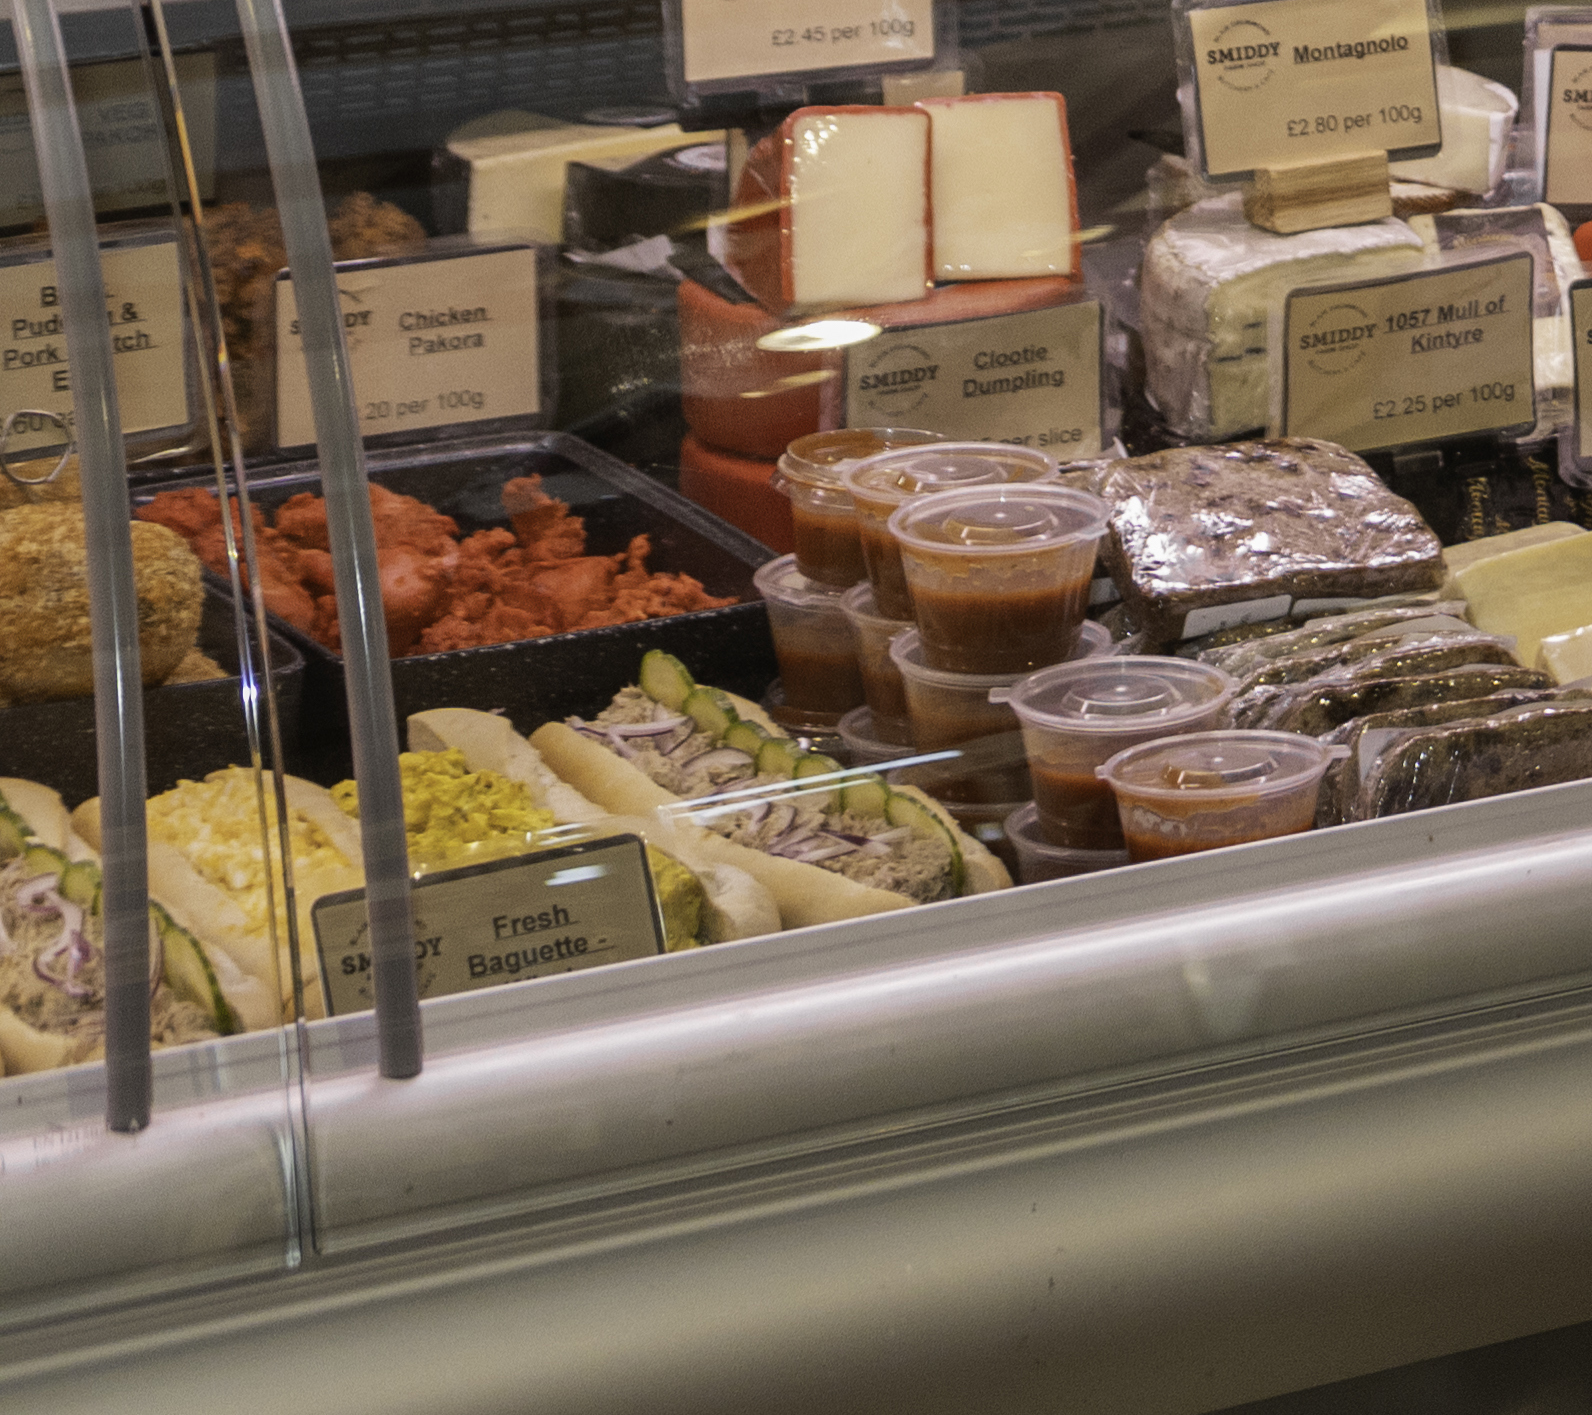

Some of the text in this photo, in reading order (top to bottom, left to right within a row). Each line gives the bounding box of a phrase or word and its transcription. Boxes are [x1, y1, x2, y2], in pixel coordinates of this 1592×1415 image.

[772, 19, 915, 47] £2.45 per 100g
[1207, 34, 1409, 65] SMIDDY Montagnolo
[1287, 104, 1423, 138] £2.80 per 100g
[399, 305, 490, 331] Chicken
[1300, 295, 1508, 350] SMIDDY 1057 Mull of
[3, 343, 60, 370] Pork
[409, 332, 485, 357] Pakora
[1410, 327, 1485, 356] Kintyre
[859, 344, 1048, 390] SMIDDY Clootie
[962, 369, 1064, 399] Dumpling
[396, 388, 485, 417] per 100g
[1373, 382, 1515, 421] £2.25 per 100g
[1038, 426, 1084, 448] slice
[492, 904, 571, 939] Fresh
[467, 933, 590, 979] Baguette
